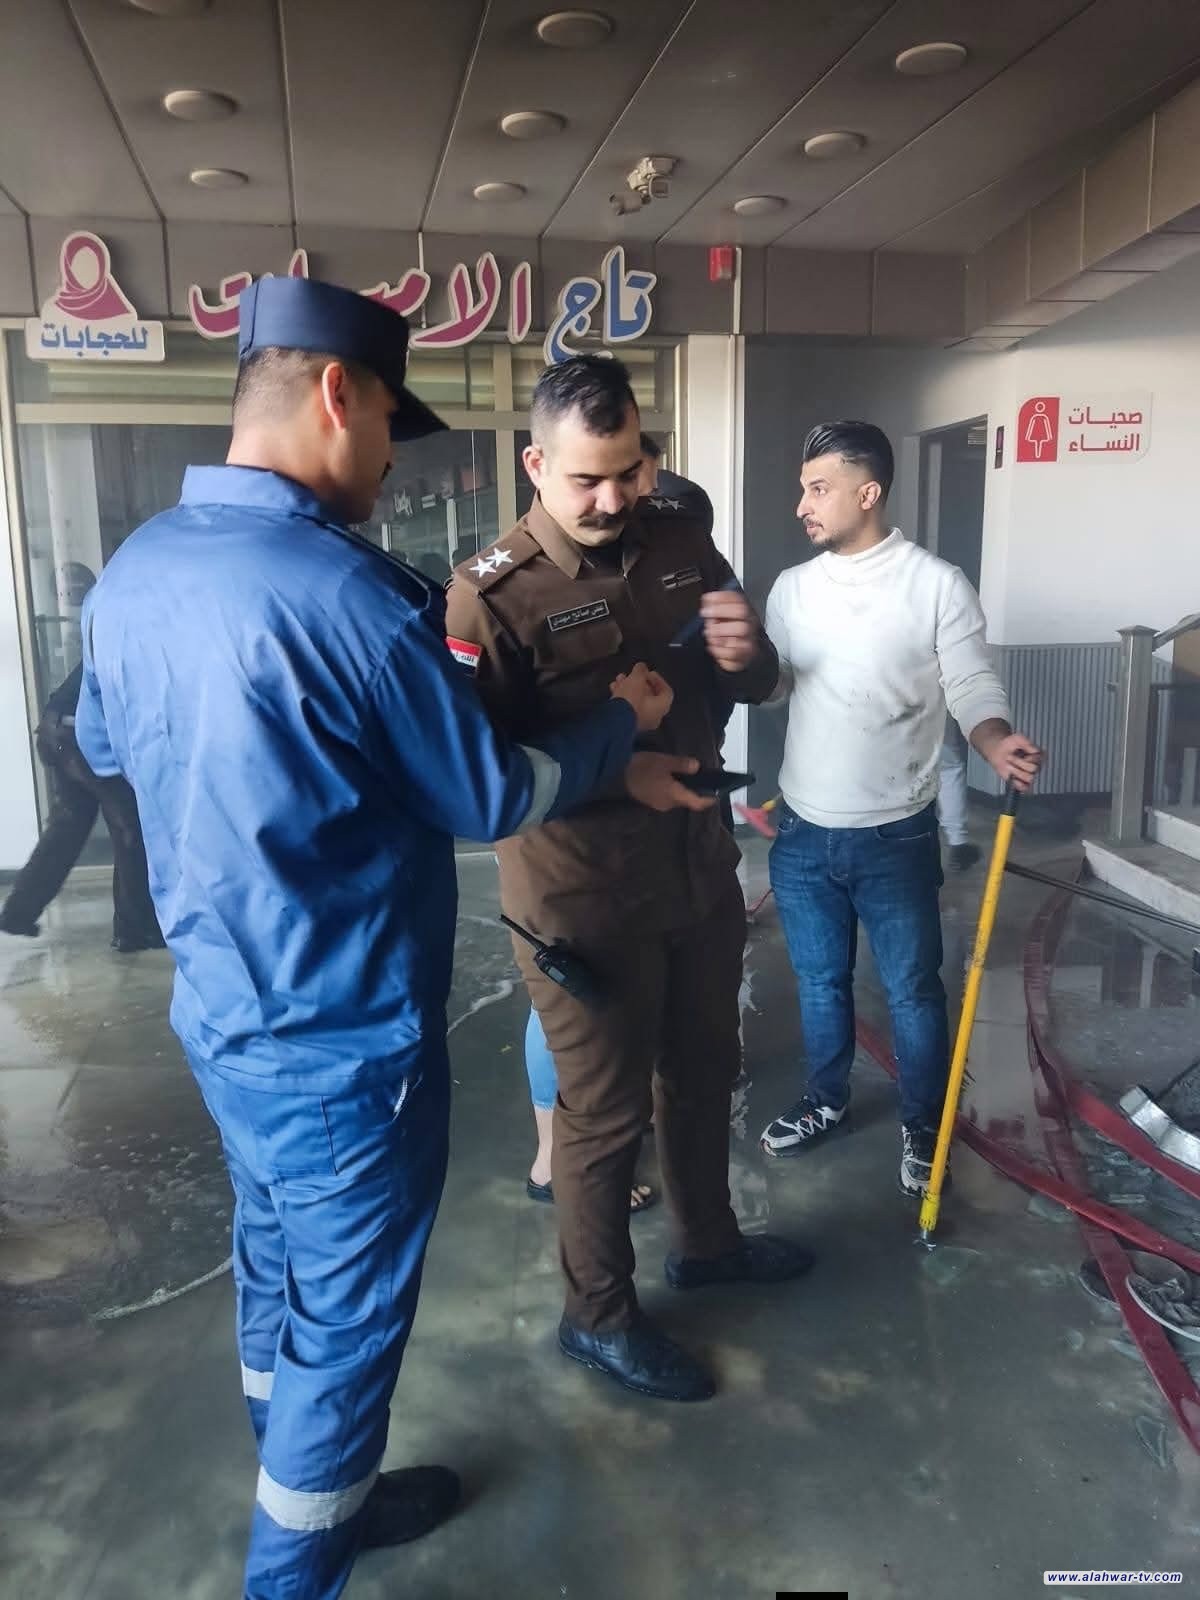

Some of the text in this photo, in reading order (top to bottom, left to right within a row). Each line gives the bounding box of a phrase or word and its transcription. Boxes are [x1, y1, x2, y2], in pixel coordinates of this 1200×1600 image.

[542, 245, 657, 365] تاج
[41, 322, 148, 357] للحجابات
[1068, 406, 1143, 429] صحيات
[1068, 433, 1140, 452] النساء
